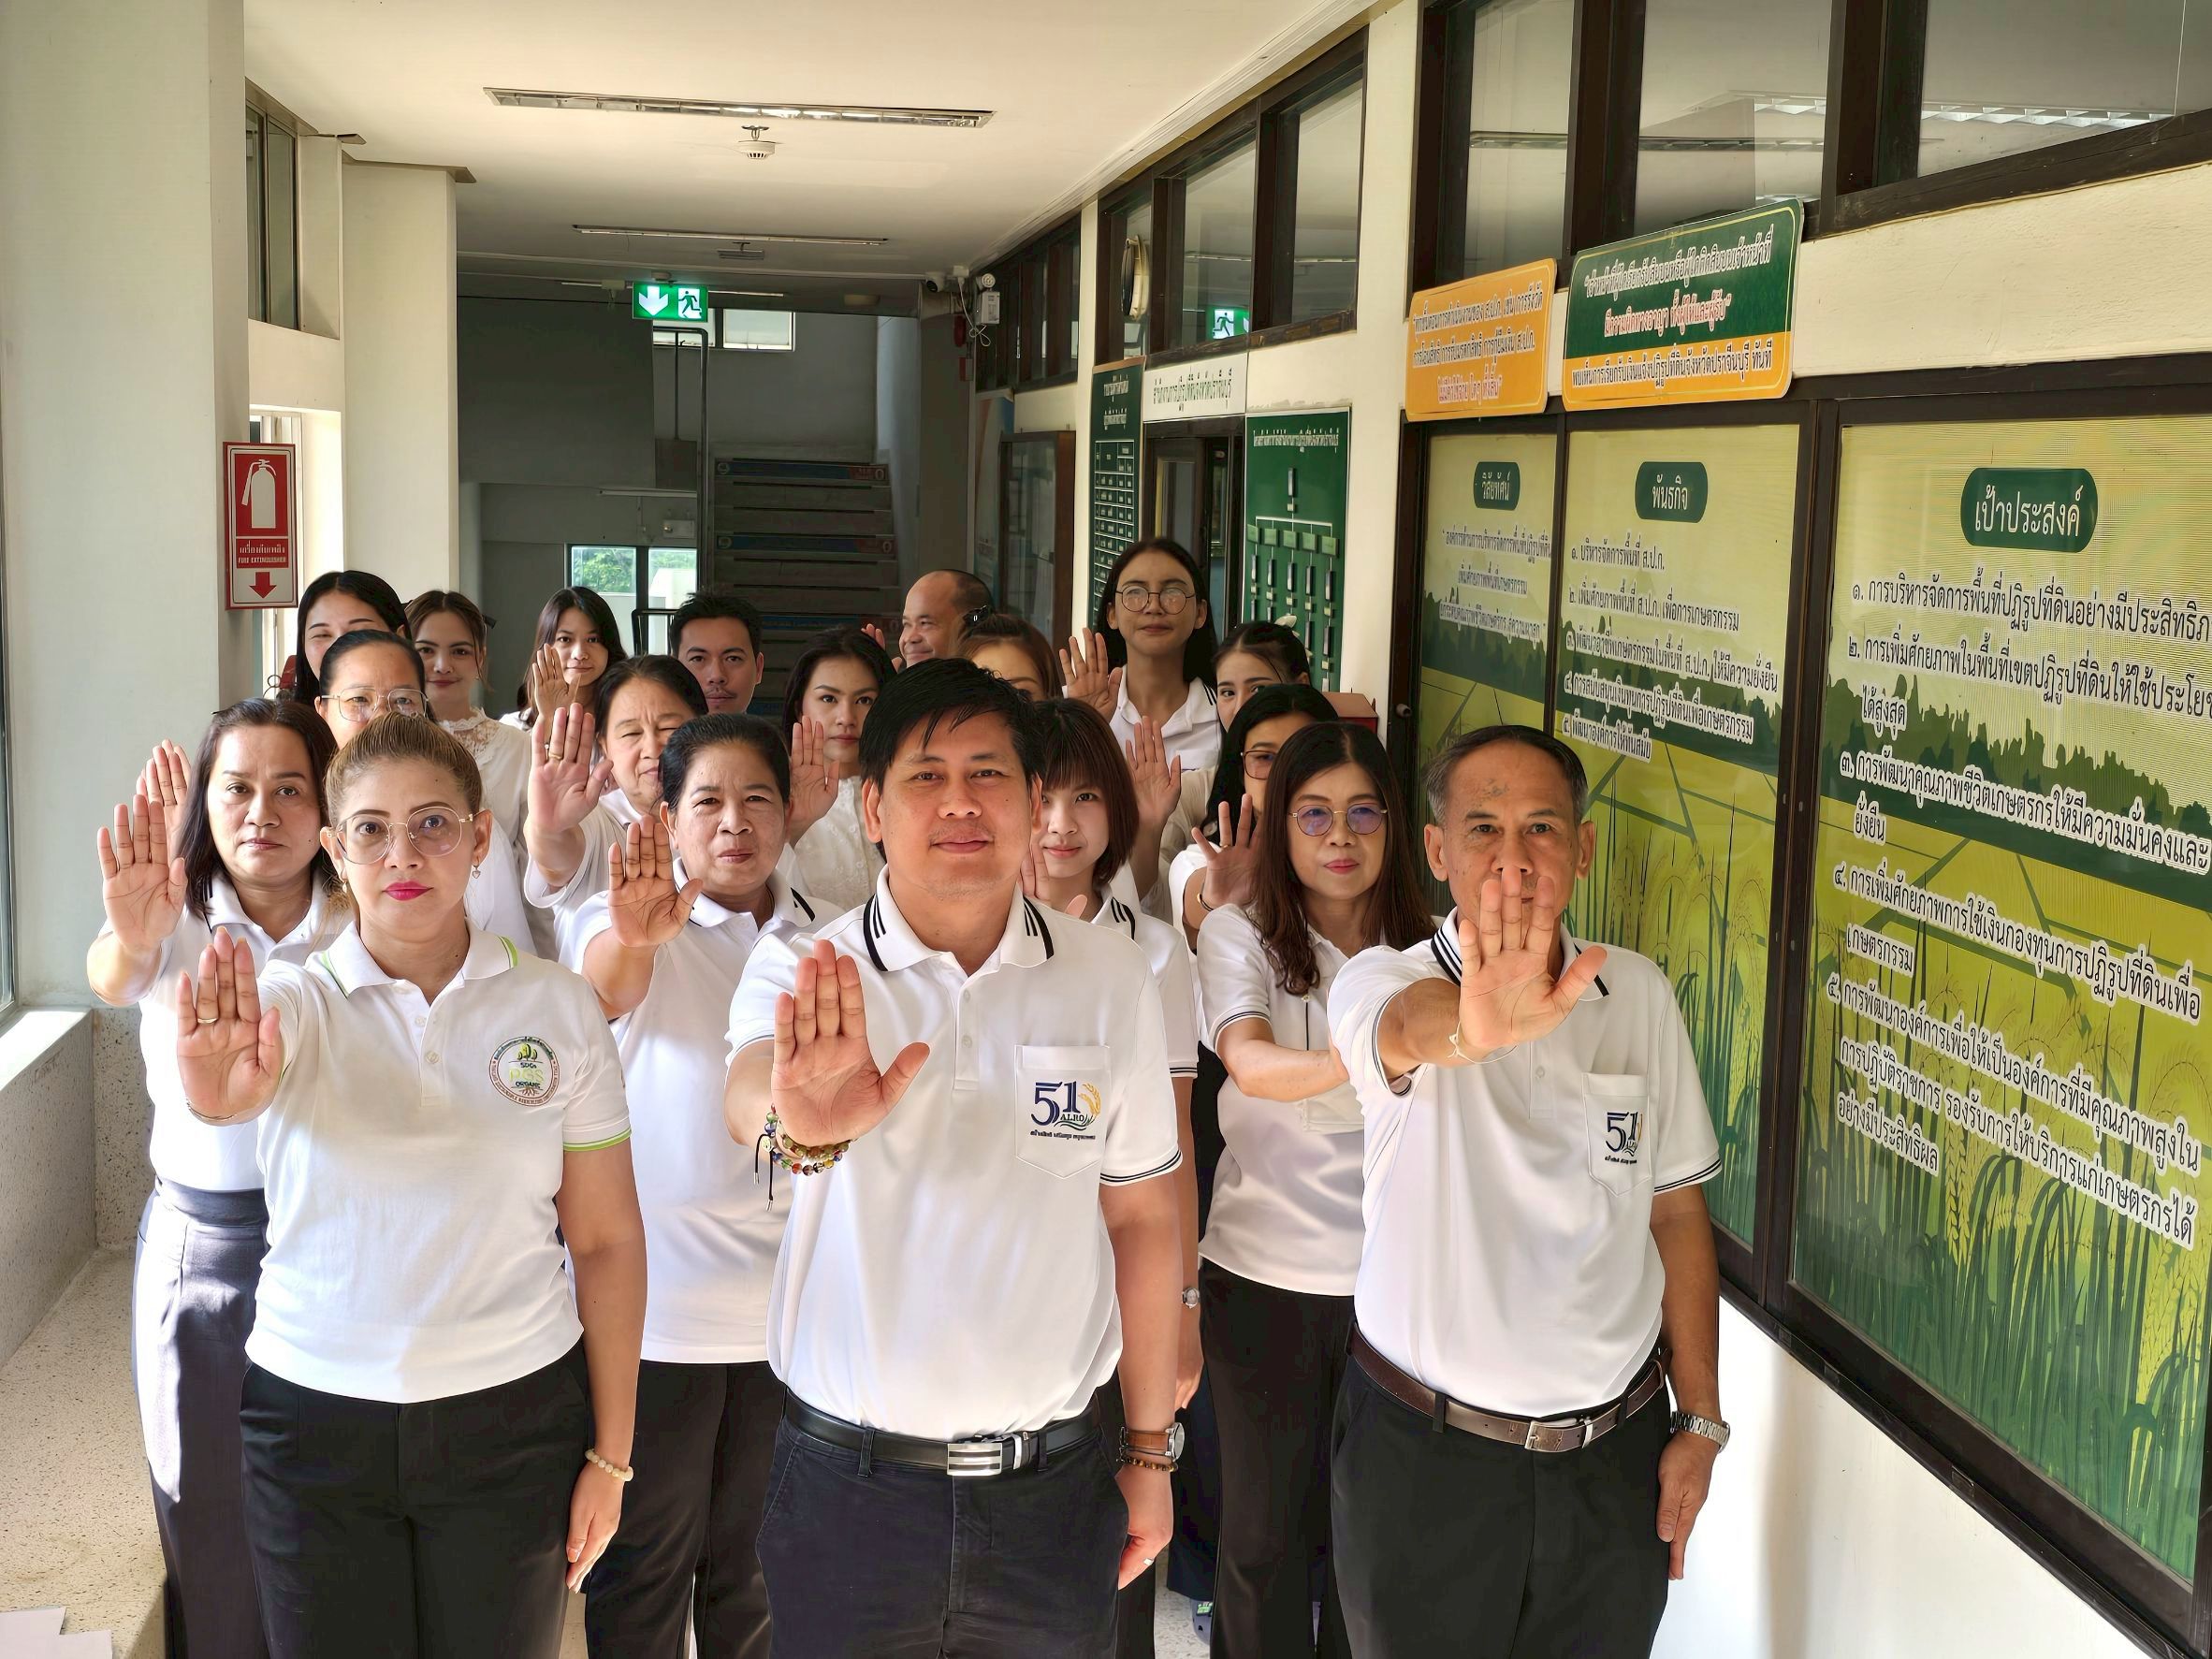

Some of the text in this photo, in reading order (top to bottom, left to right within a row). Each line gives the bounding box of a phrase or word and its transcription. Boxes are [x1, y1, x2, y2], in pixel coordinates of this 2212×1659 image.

[1753, 339, 1772, 370] ทันที
[1481, 471, 1511, 502] วิสัยทัศน์
[1652, 474, 1688, 510] พันธกิจ
[1974, 484, 2084, 537] เป้าประสงค์
[1580, 532, 1640, 566] บริหารจัดการพื้นที่
[1642, 546, 1665, 570] ส.ป.ก.
[1578, 577, 1636, 613] เพิ่มศักยภาพพื้นที่
[1637, 594, 1660, 618] ส.ป.ก.
[1662, 588, 1739, 632] เพื่อการเกษตรกรรม
[1852, 567, 2212, 643] ๑. การบริหารจัดการพื้นที่ปฏิรูปที่ดินอย่างมีประสิทธิภ
[1685, 651, 1710, 677] ส.ป.ก.
[1712, 649, 1778, 694] ให้มีความยั่งยืน
[1848, 636, 1860, 660] ๒.
[1574, 672, 1753, 739] การสนับสนุนเงินทุนการปฏิรูปที่ดินเพื่อเกษตรกรรม
[1861, 686, 1906, 735] ได้สูงสุด
[1572, 712, 1651, 759] พัฒนาองค์การให้ทันสมัย
[1841, 748, 2209, 870] ๓. การพัฒนาคุณภาพชีวิตเกษตรกรให้มีความมั่นคงและ
[1855, 792, 1885, 841] ยั่งยืน
[1834, 859, 2201, 1020] ๔. การเพิ่มศักยภาพการใช้เงินกองทุนการปฏิรูปที่ดินเพื่อ
[1847, 926, 1914, 973] เกษตรกรรม
[509, 1068, 544, 1083] PGS
[1827, 975, 2199, 1173] ๕. การพัฒนาองค์การเพื่อให้เป็นองค์การที่มีคุณภาพสูงใน
[1031, 1081, 1081, 1126] 51
[1606, 1112, 1638, 1152] 51
[1839, 1090, 1939, 1171] อย่างมีประสิทธิผล
[1841, 1038, 2193, 1245] การปฏิบัติราชการ รองรับการให้บริการแก่เกษตรกรได้
